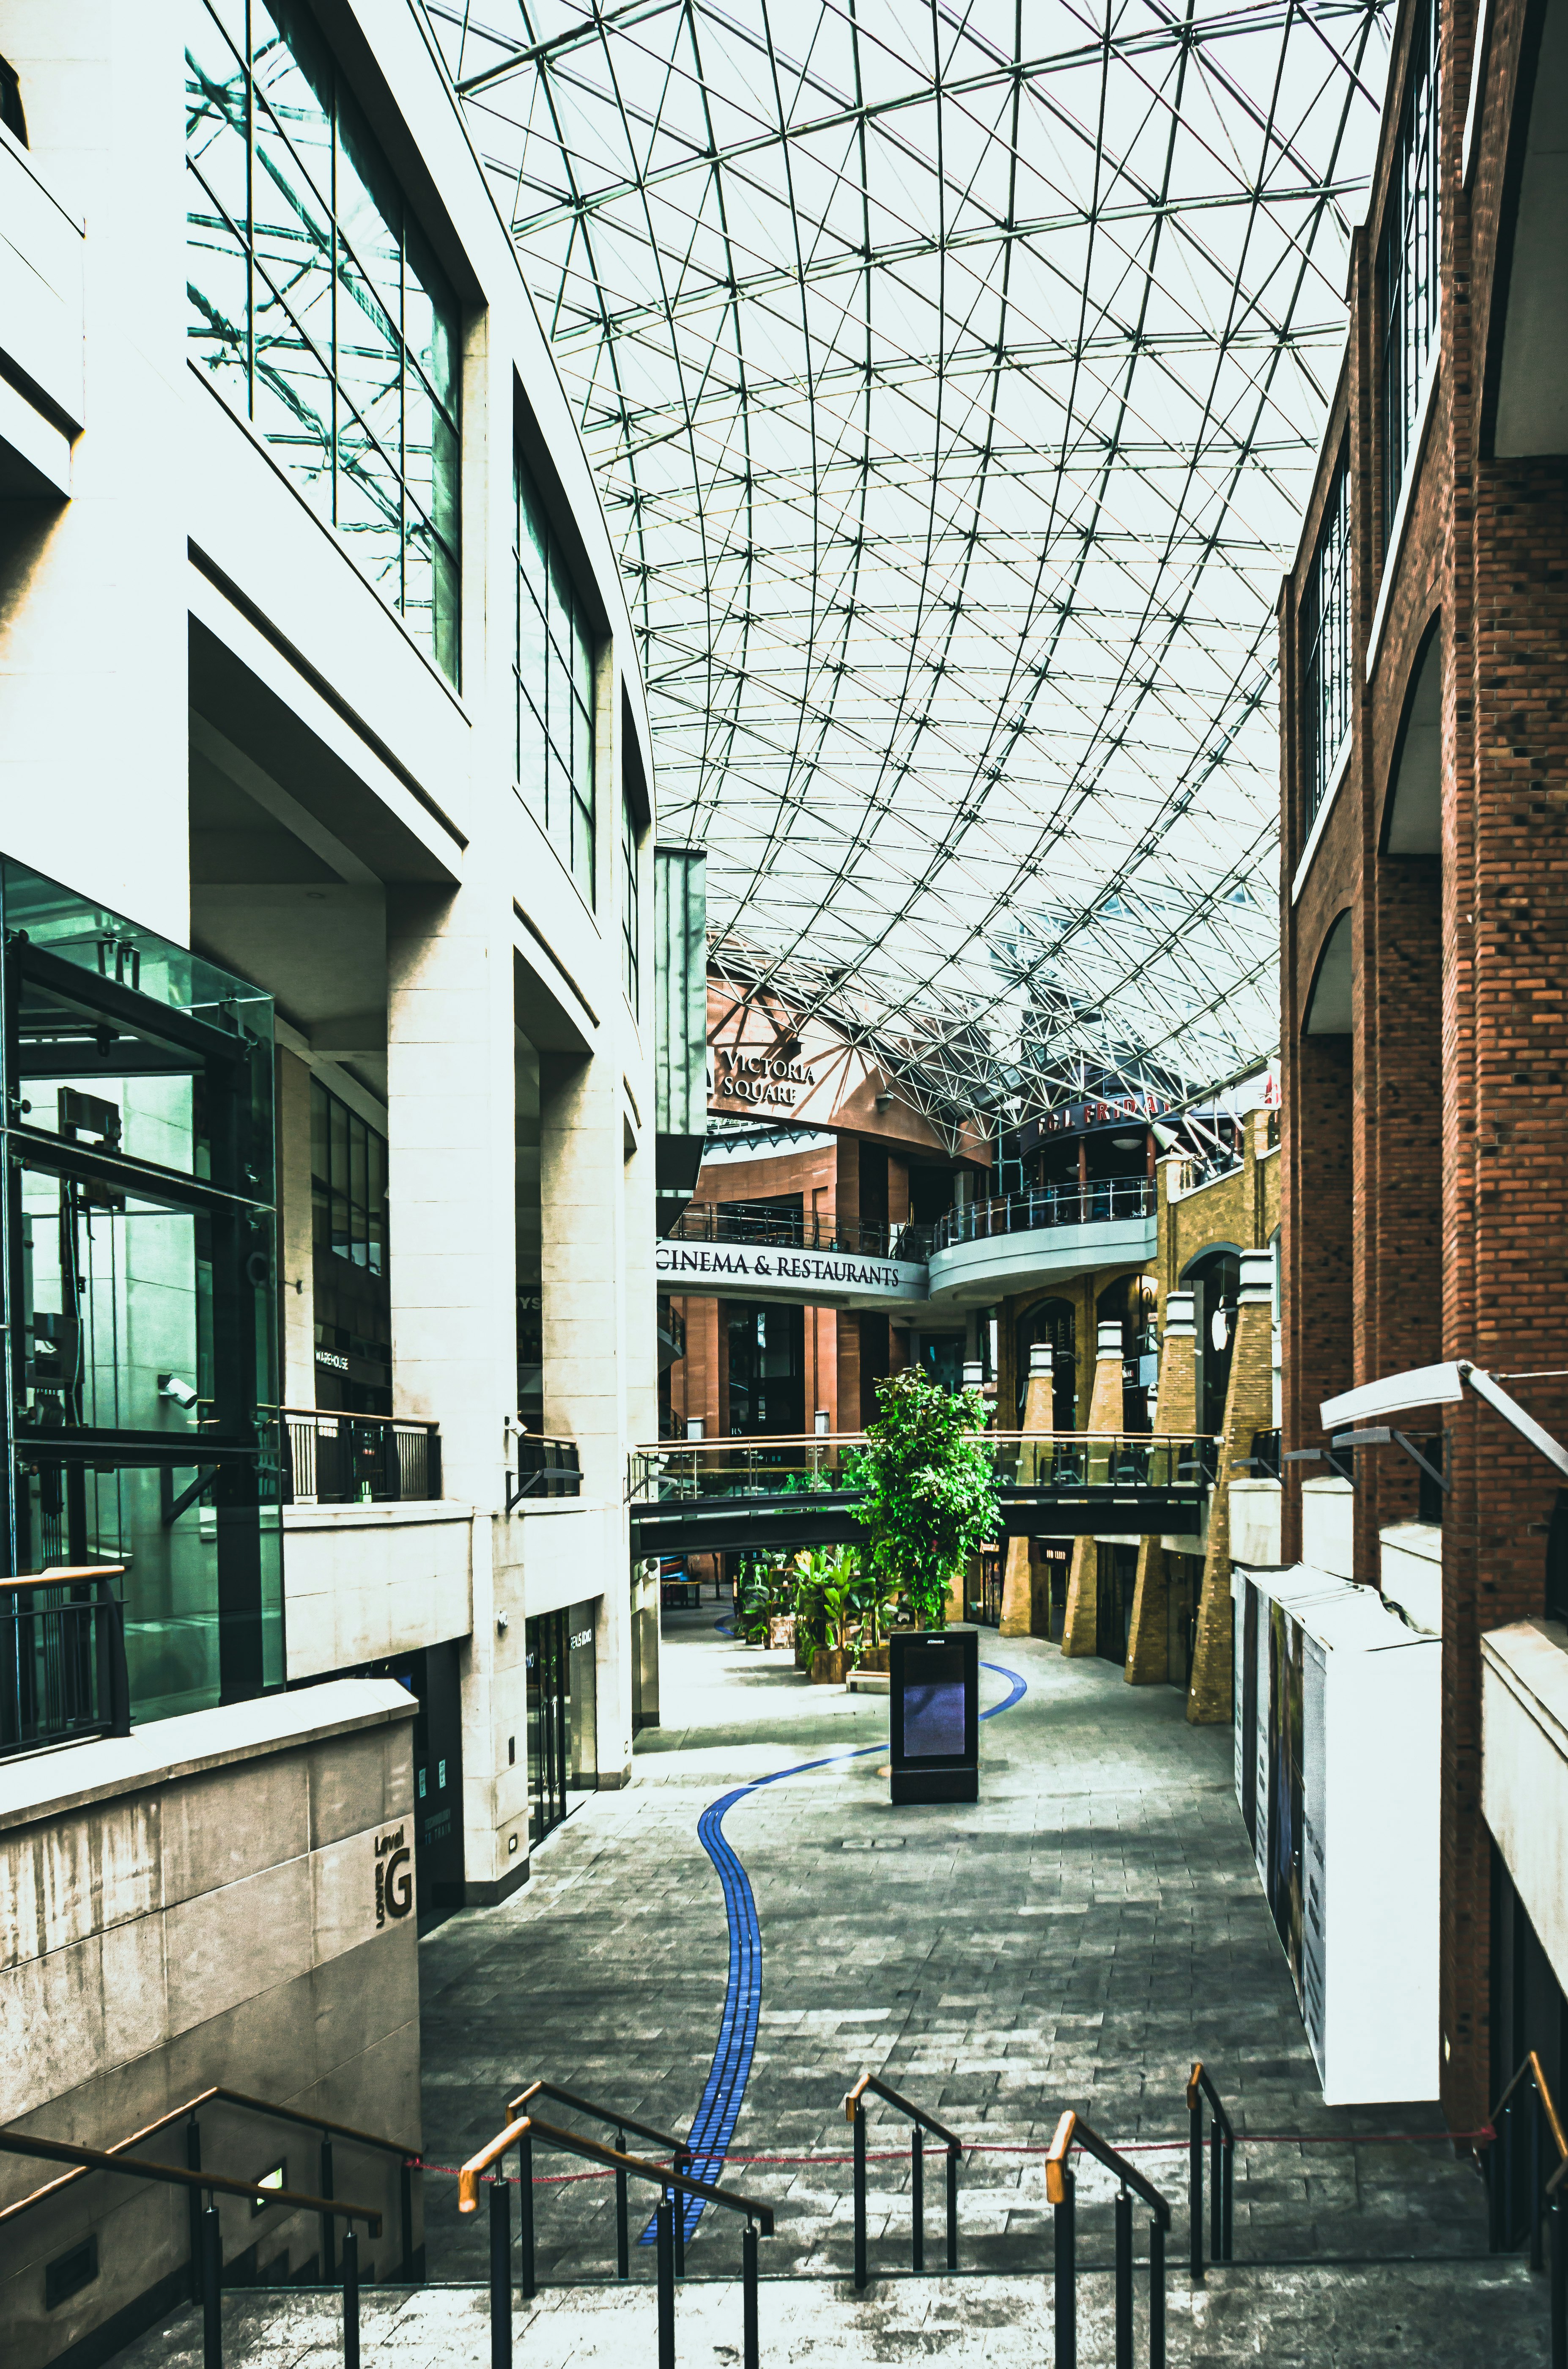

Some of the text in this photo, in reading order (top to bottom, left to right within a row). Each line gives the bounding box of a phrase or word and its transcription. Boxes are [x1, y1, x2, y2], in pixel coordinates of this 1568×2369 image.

[724, 1050, 816, 1083] VICTORIA
[724, 1076, 797, 1104] SQUARE
[656, 1249, 899, 1287] CINEMA & RESTAURANTS
[315, 1349, 348, 1370] WAREHOUSE
[375, 1823, 404, 1857] Level
[376, 1861, 385, 1929] LOWER
[385, 1847, 412, 1918] G
